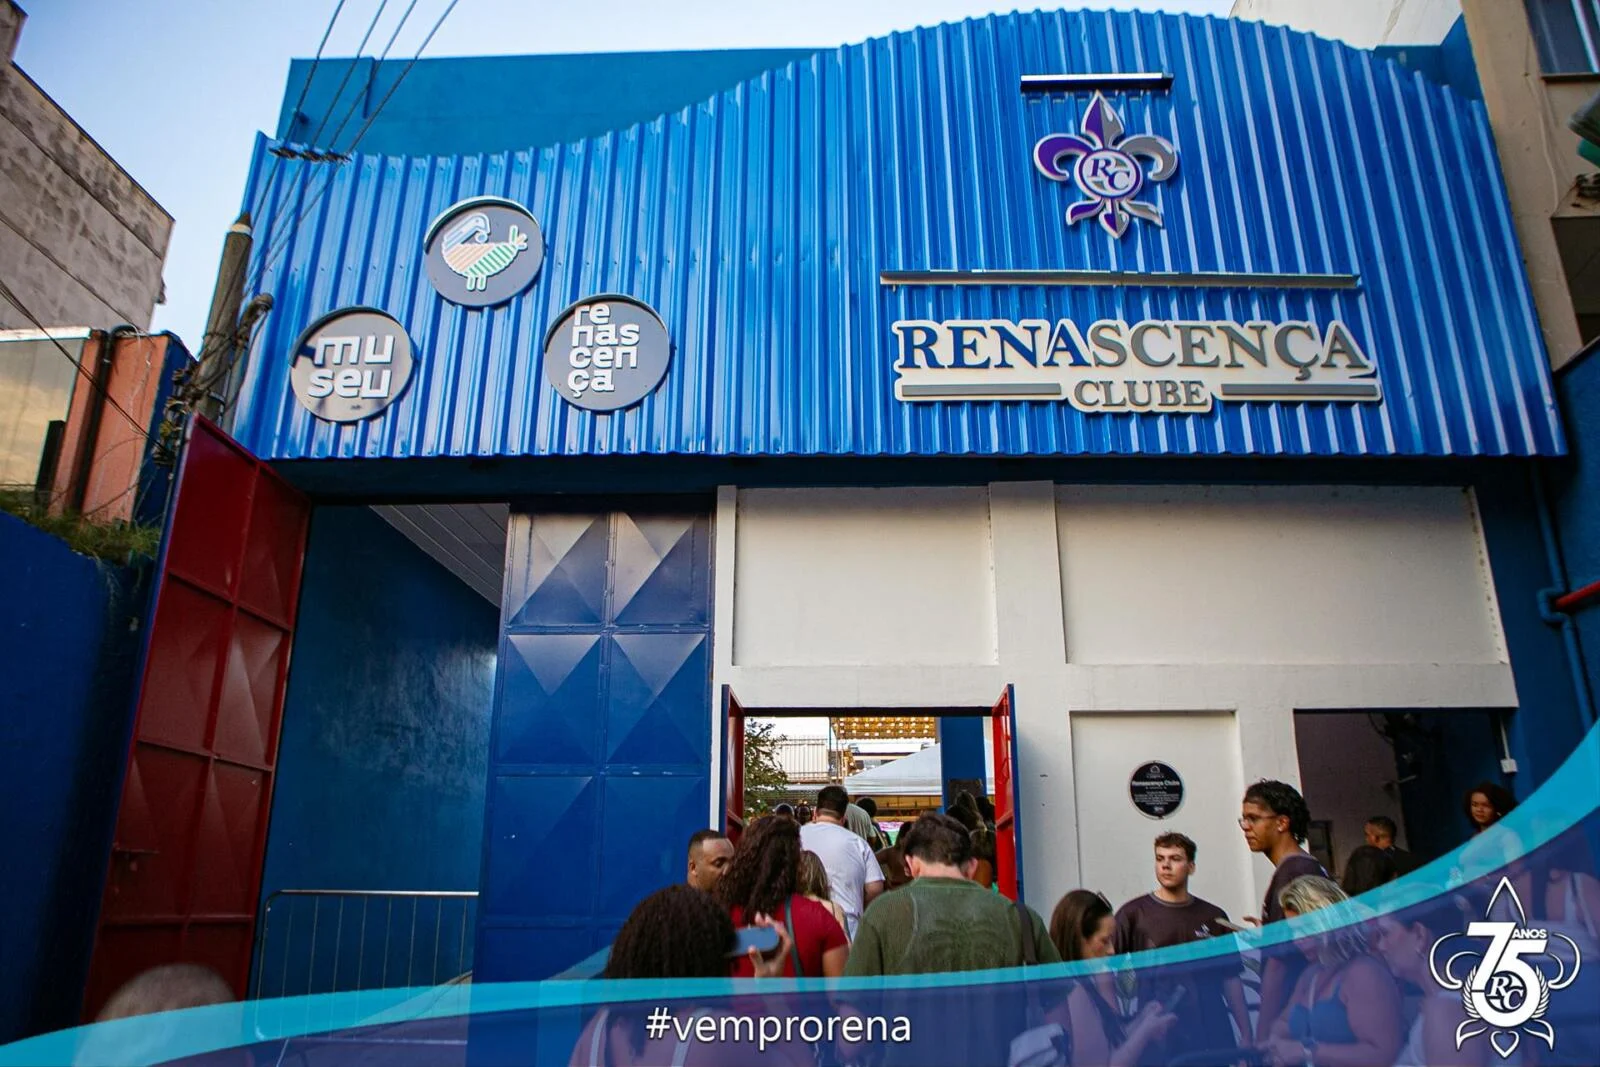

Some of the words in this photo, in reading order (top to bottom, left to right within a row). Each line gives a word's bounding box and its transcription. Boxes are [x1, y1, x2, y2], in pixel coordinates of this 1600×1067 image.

[574, 303, 610, 325] re
[571, 323, 640, 347] nas
[314, 335, 395, 366] mu
[569, 346, 638, 369] cen
[897, 322, 1370, 381] RENASCENÇA
[308, 368, 392, 399] seu
[567, 369, 615, 398] ça
[1073, 380, 1208, 406] CLUBE
